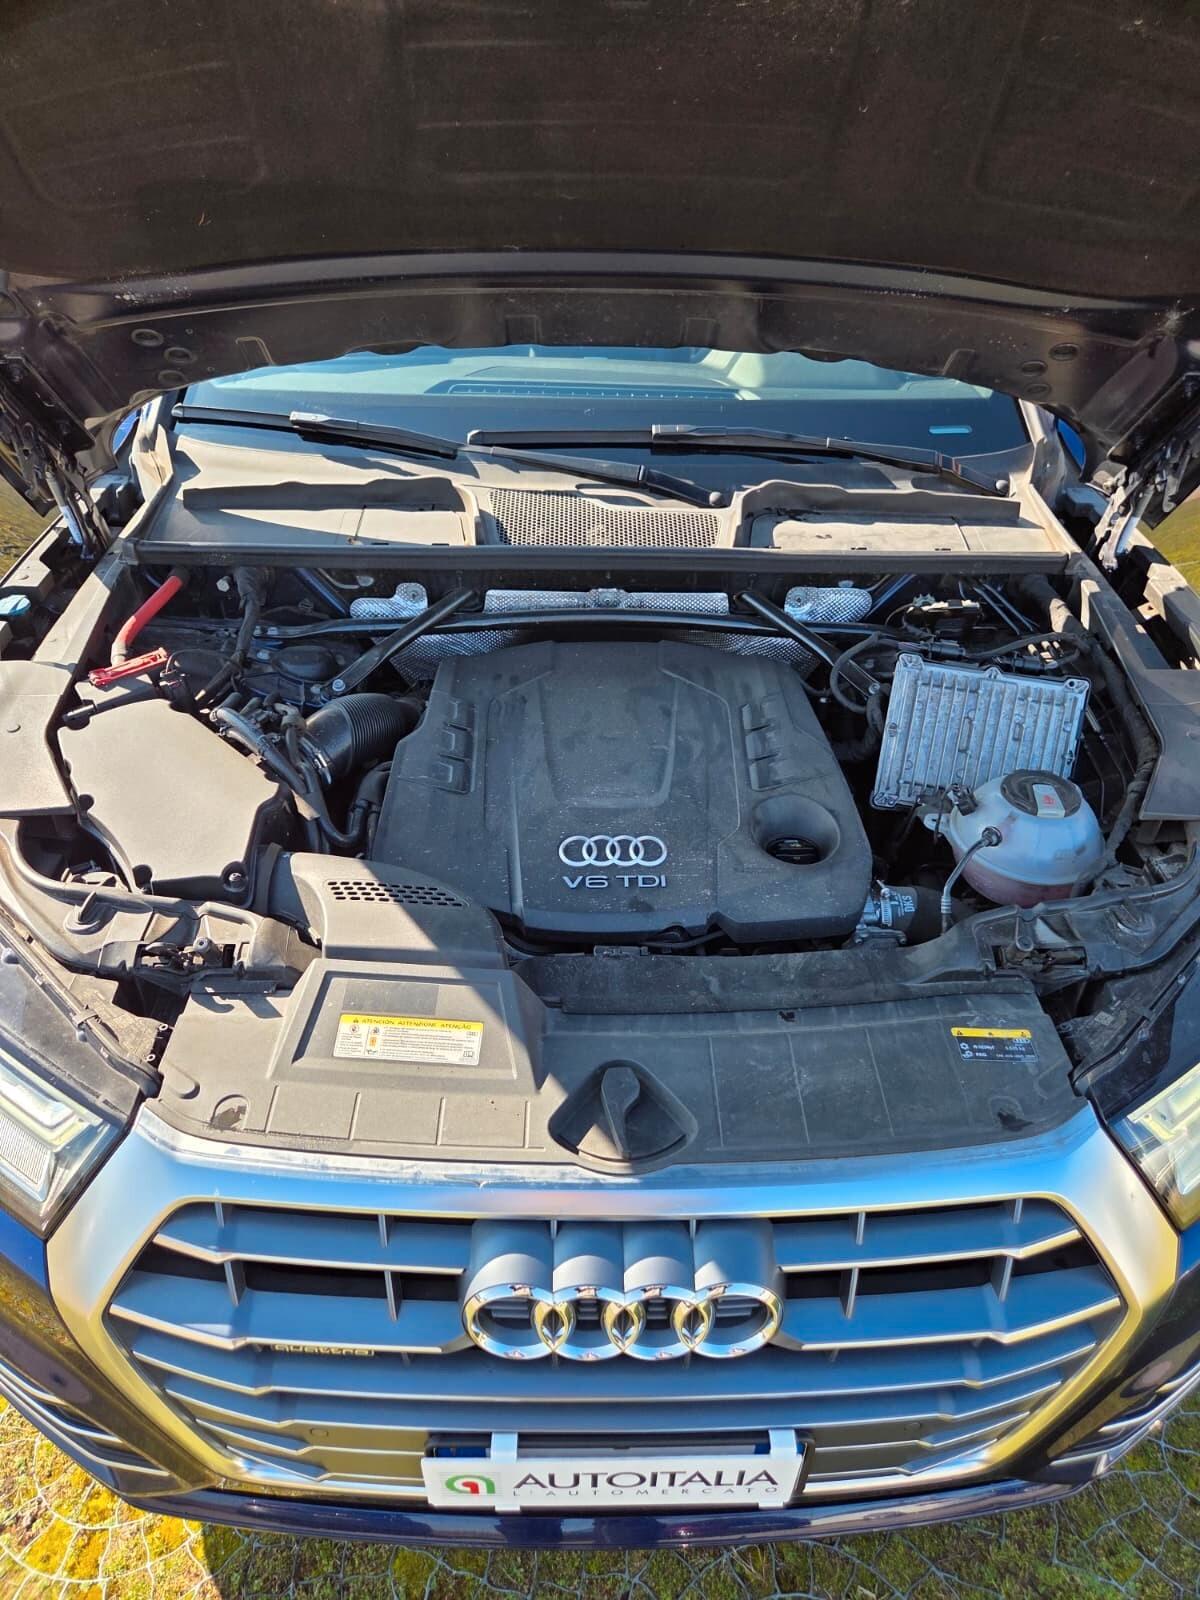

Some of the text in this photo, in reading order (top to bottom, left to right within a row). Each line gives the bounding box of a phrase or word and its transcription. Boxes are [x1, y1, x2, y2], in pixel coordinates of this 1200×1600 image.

[562, 874, 666, 888] V6 TDI
[513, 1470, 778, 1489] AUTOITALIA
